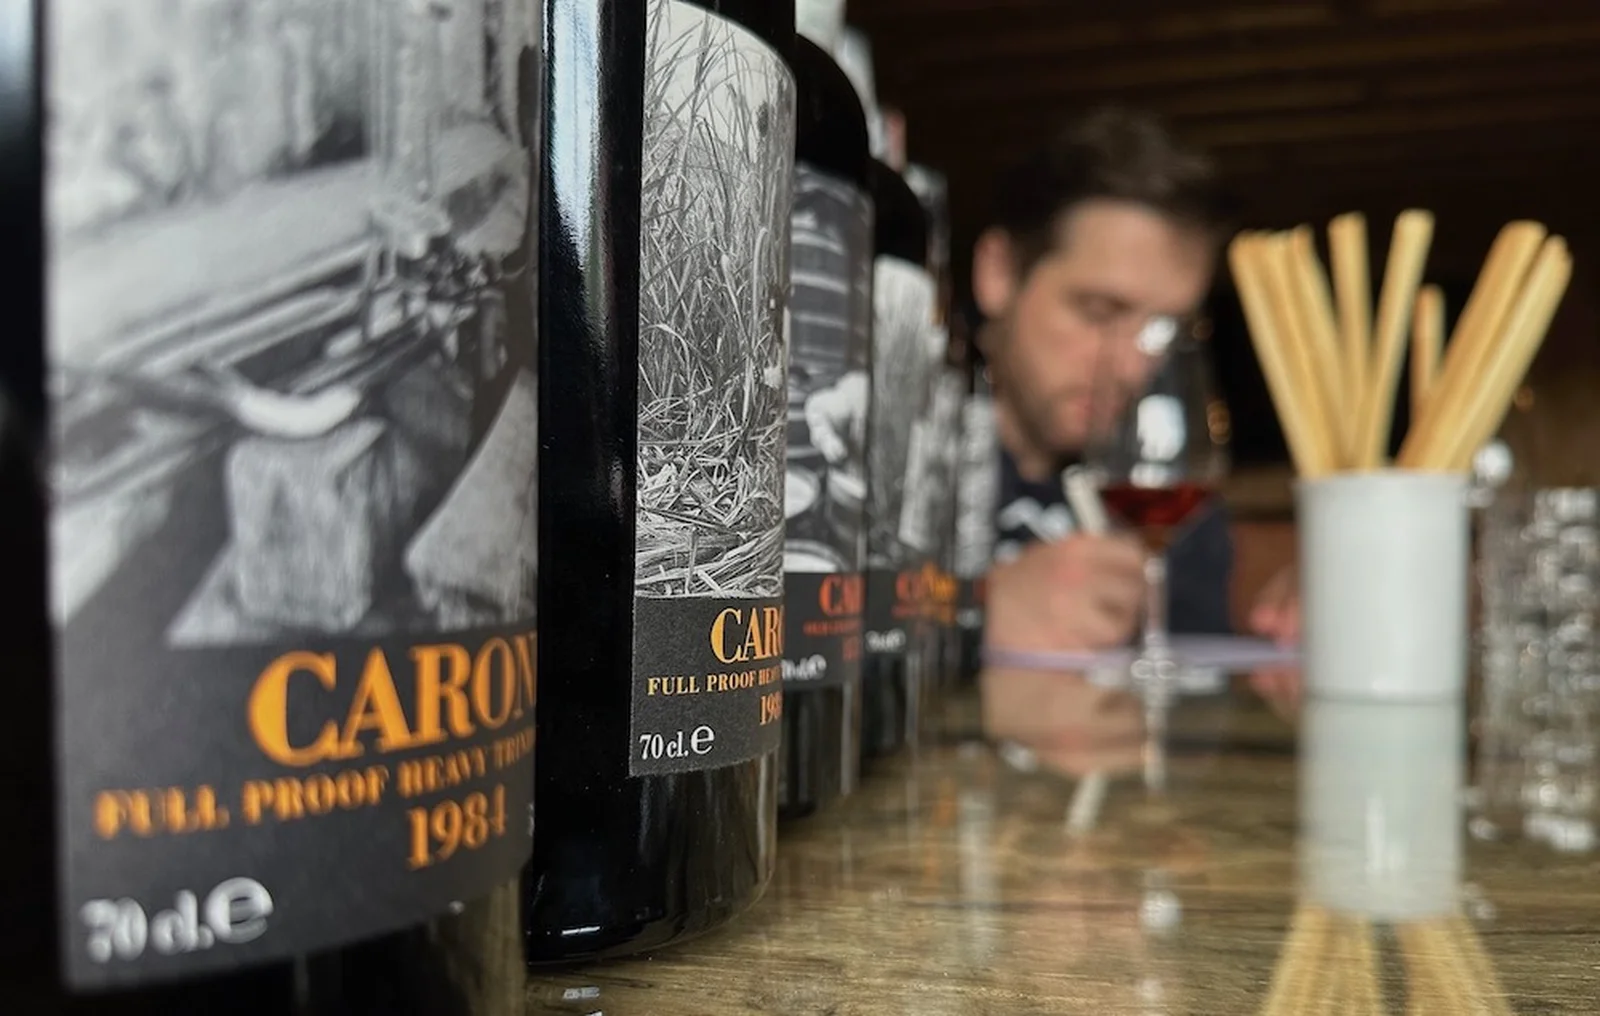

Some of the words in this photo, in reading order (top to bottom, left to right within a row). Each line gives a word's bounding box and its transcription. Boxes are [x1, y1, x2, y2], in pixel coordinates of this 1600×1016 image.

[647, 675, 700, 696] FULL
[706, 669, 757, 692] PROOF
[94, 784, 230, 841] FULL
[242, 763, 388, 826] PROOF
[397, 745, 487, 799] HEAVY
[405, 782, 507, 871] 1984
